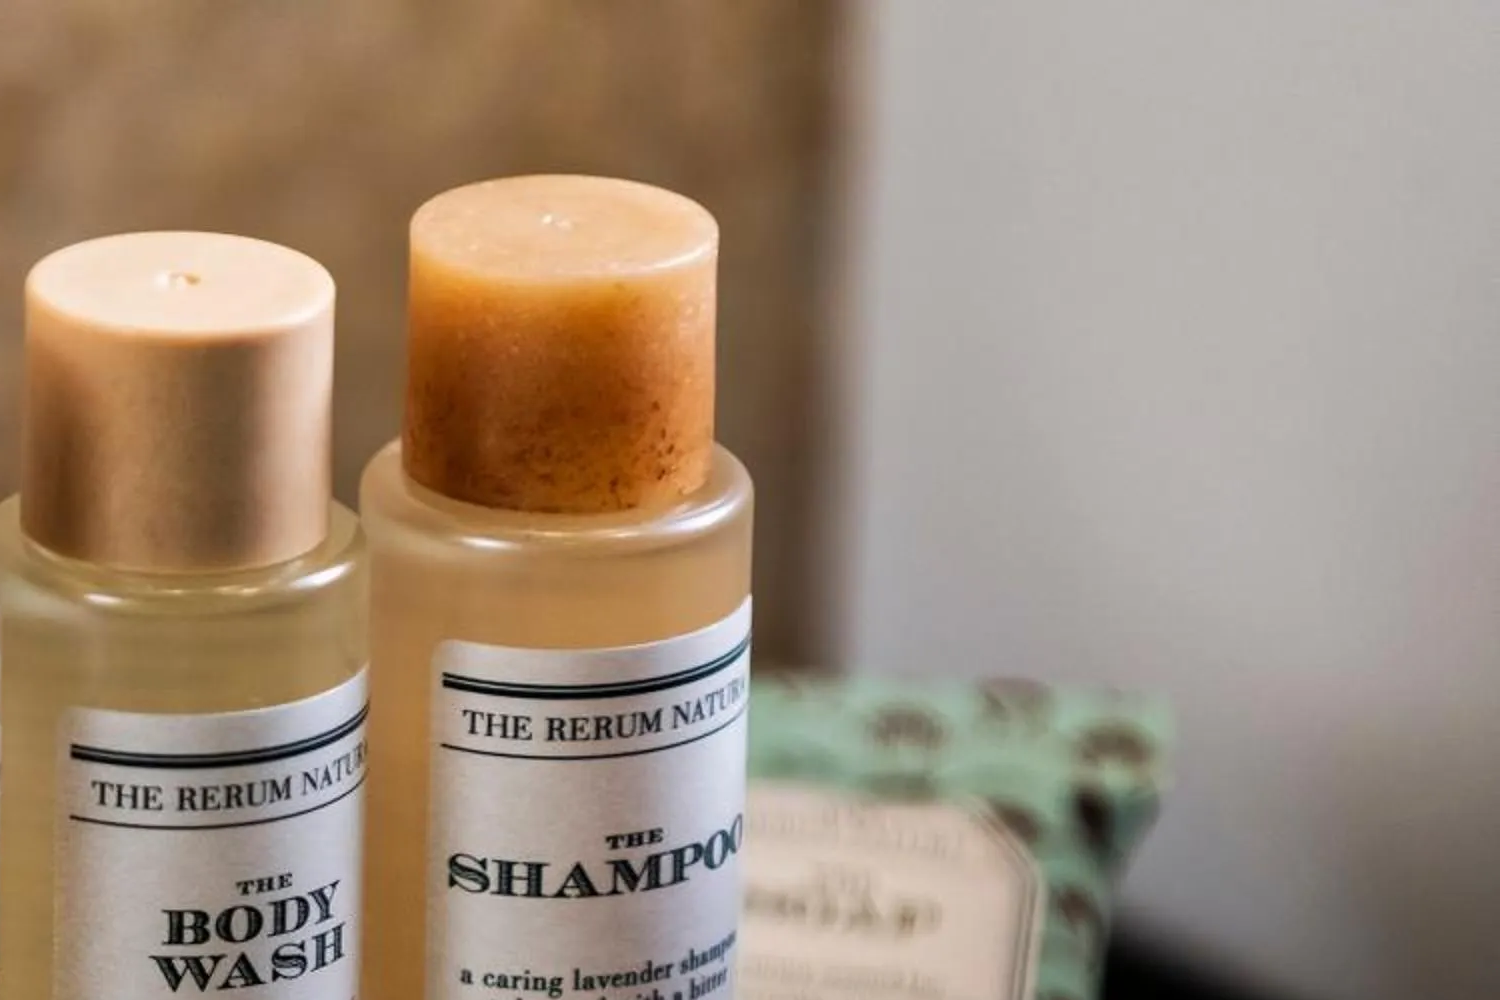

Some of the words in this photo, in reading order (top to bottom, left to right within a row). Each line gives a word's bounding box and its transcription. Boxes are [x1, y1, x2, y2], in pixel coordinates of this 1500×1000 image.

[463, 708, 533, 741] THE
[544, 708, 664, 742] RERUM
[92, 780, 163, 811] THE
[176, 776, 292, 812] RERUM
[448, 812, 743, 898] SHAMPOO
[605, 827, 663, 850] THE
[236, 872, 293, 896] THE
[161, 880, 341, 946] BODY
[148, 922, 346, 993] WASH
[460, 968, 473, 985] a
[483, 970, 564, 998] caring
[572, 960, 674, 991] lavender
[689, 967, 728, 1000] bitter
